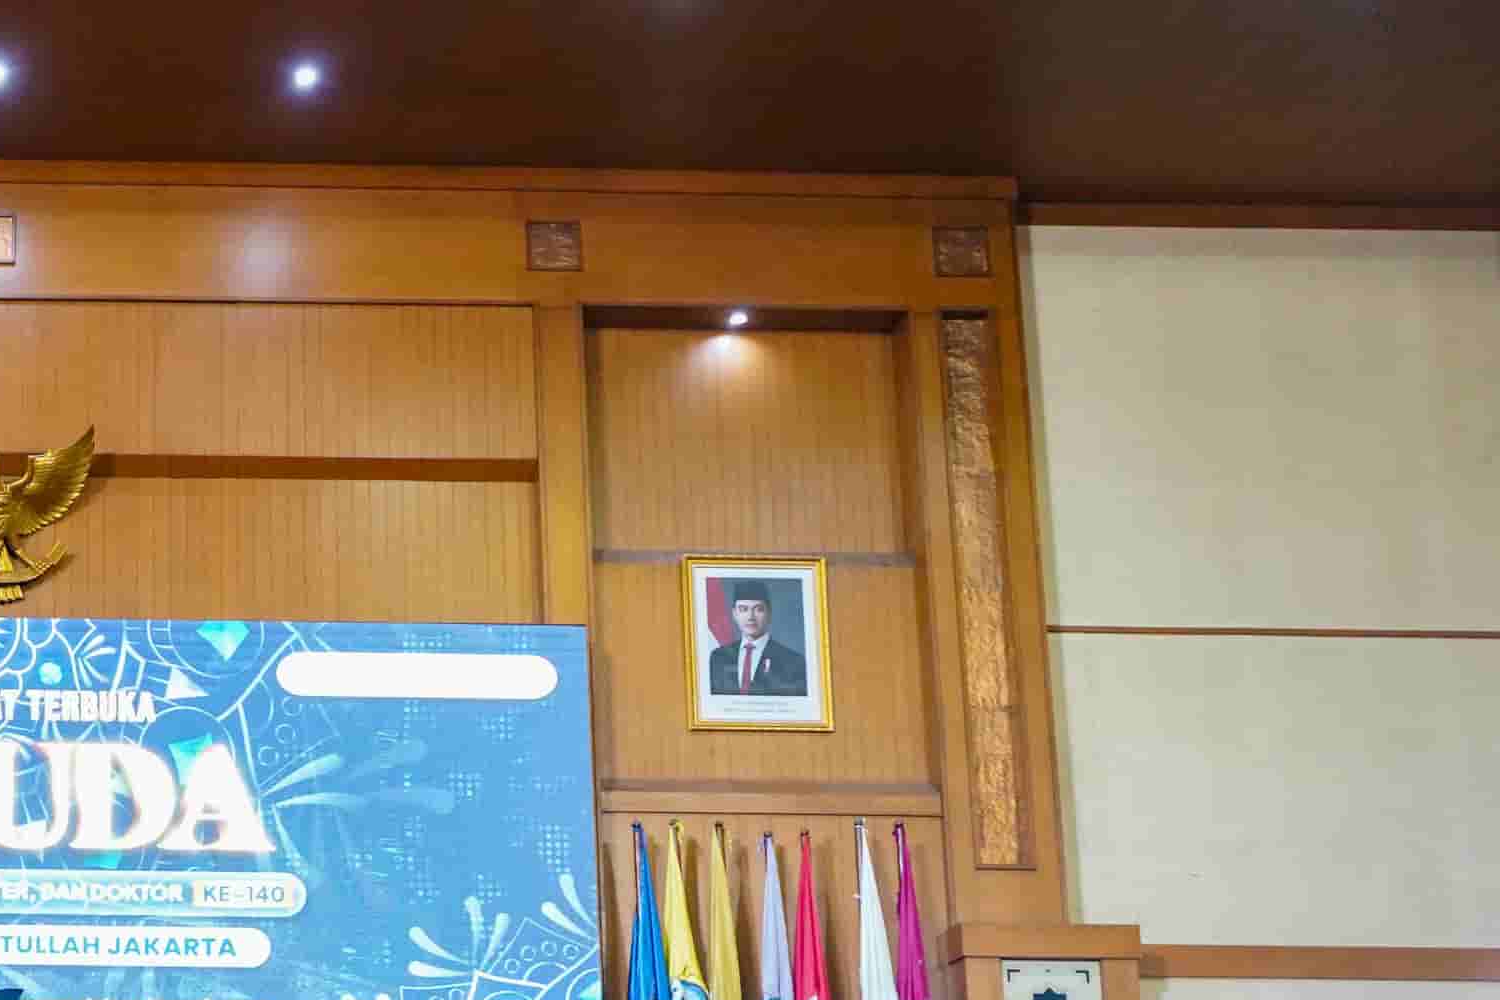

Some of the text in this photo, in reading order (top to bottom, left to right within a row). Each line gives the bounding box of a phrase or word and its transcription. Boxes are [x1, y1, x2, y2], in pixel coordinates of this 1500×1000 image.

[27, 689, 156, 723] TERBUKA
[87, 882, 184, 903] DOKTOR
[203, 885, 286, 903] KE-140
[108, 937, 237, 956] JAKARTA
